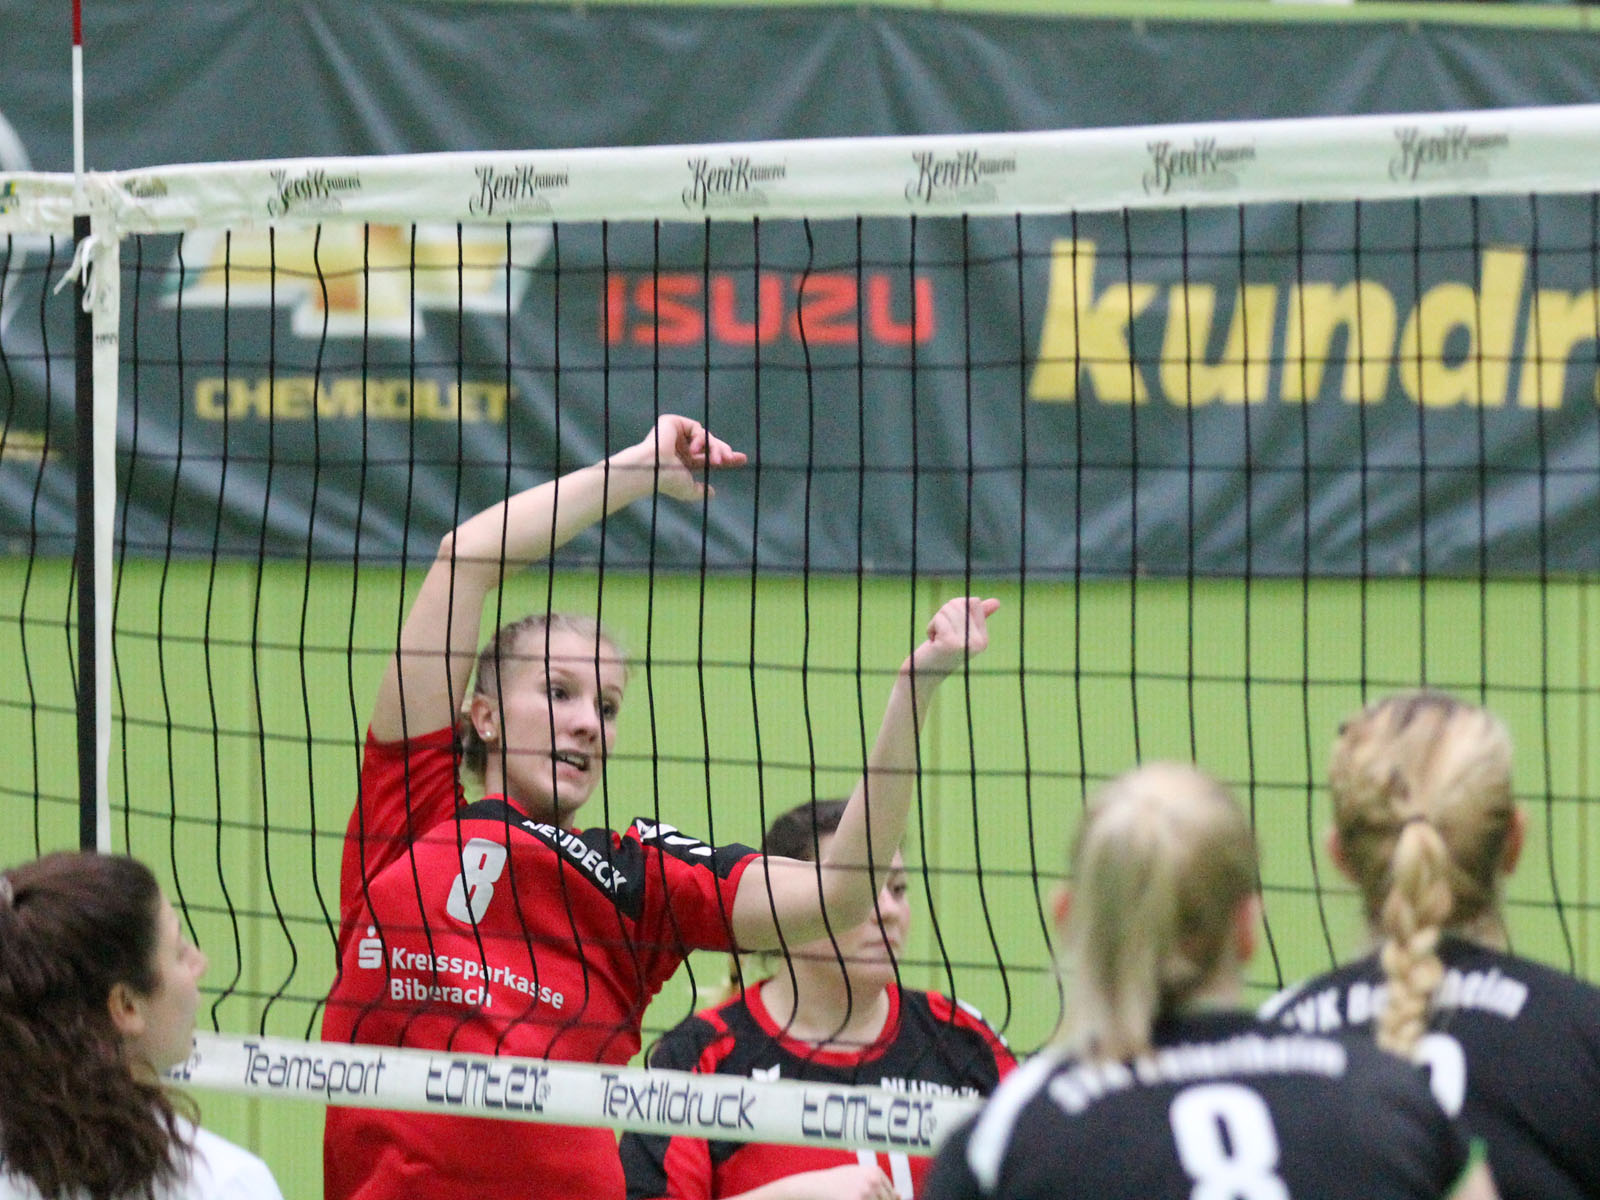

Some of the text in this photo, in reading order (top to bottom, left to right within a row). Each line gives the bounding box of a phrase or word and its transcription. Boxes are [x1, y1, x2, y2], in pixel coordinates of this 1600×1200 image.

[600, 273, 934, 345] ISUZU
[1028, 238, 1600, 409] kundr
[195, 377, 511, 423] CHEVROLET
[446, 837, 508, 926] 8
[522, 819, 628, 893] NEUDECK
[390, 978, 493, 1008] Biberach
[391, 947, 564, 1010] Kreissparkasse
[243, 1041, 386, 1100] Teamsport
[600, 1073, 756, 1131] Textildruck
[1169, 1082, 1291, 1200] 8
